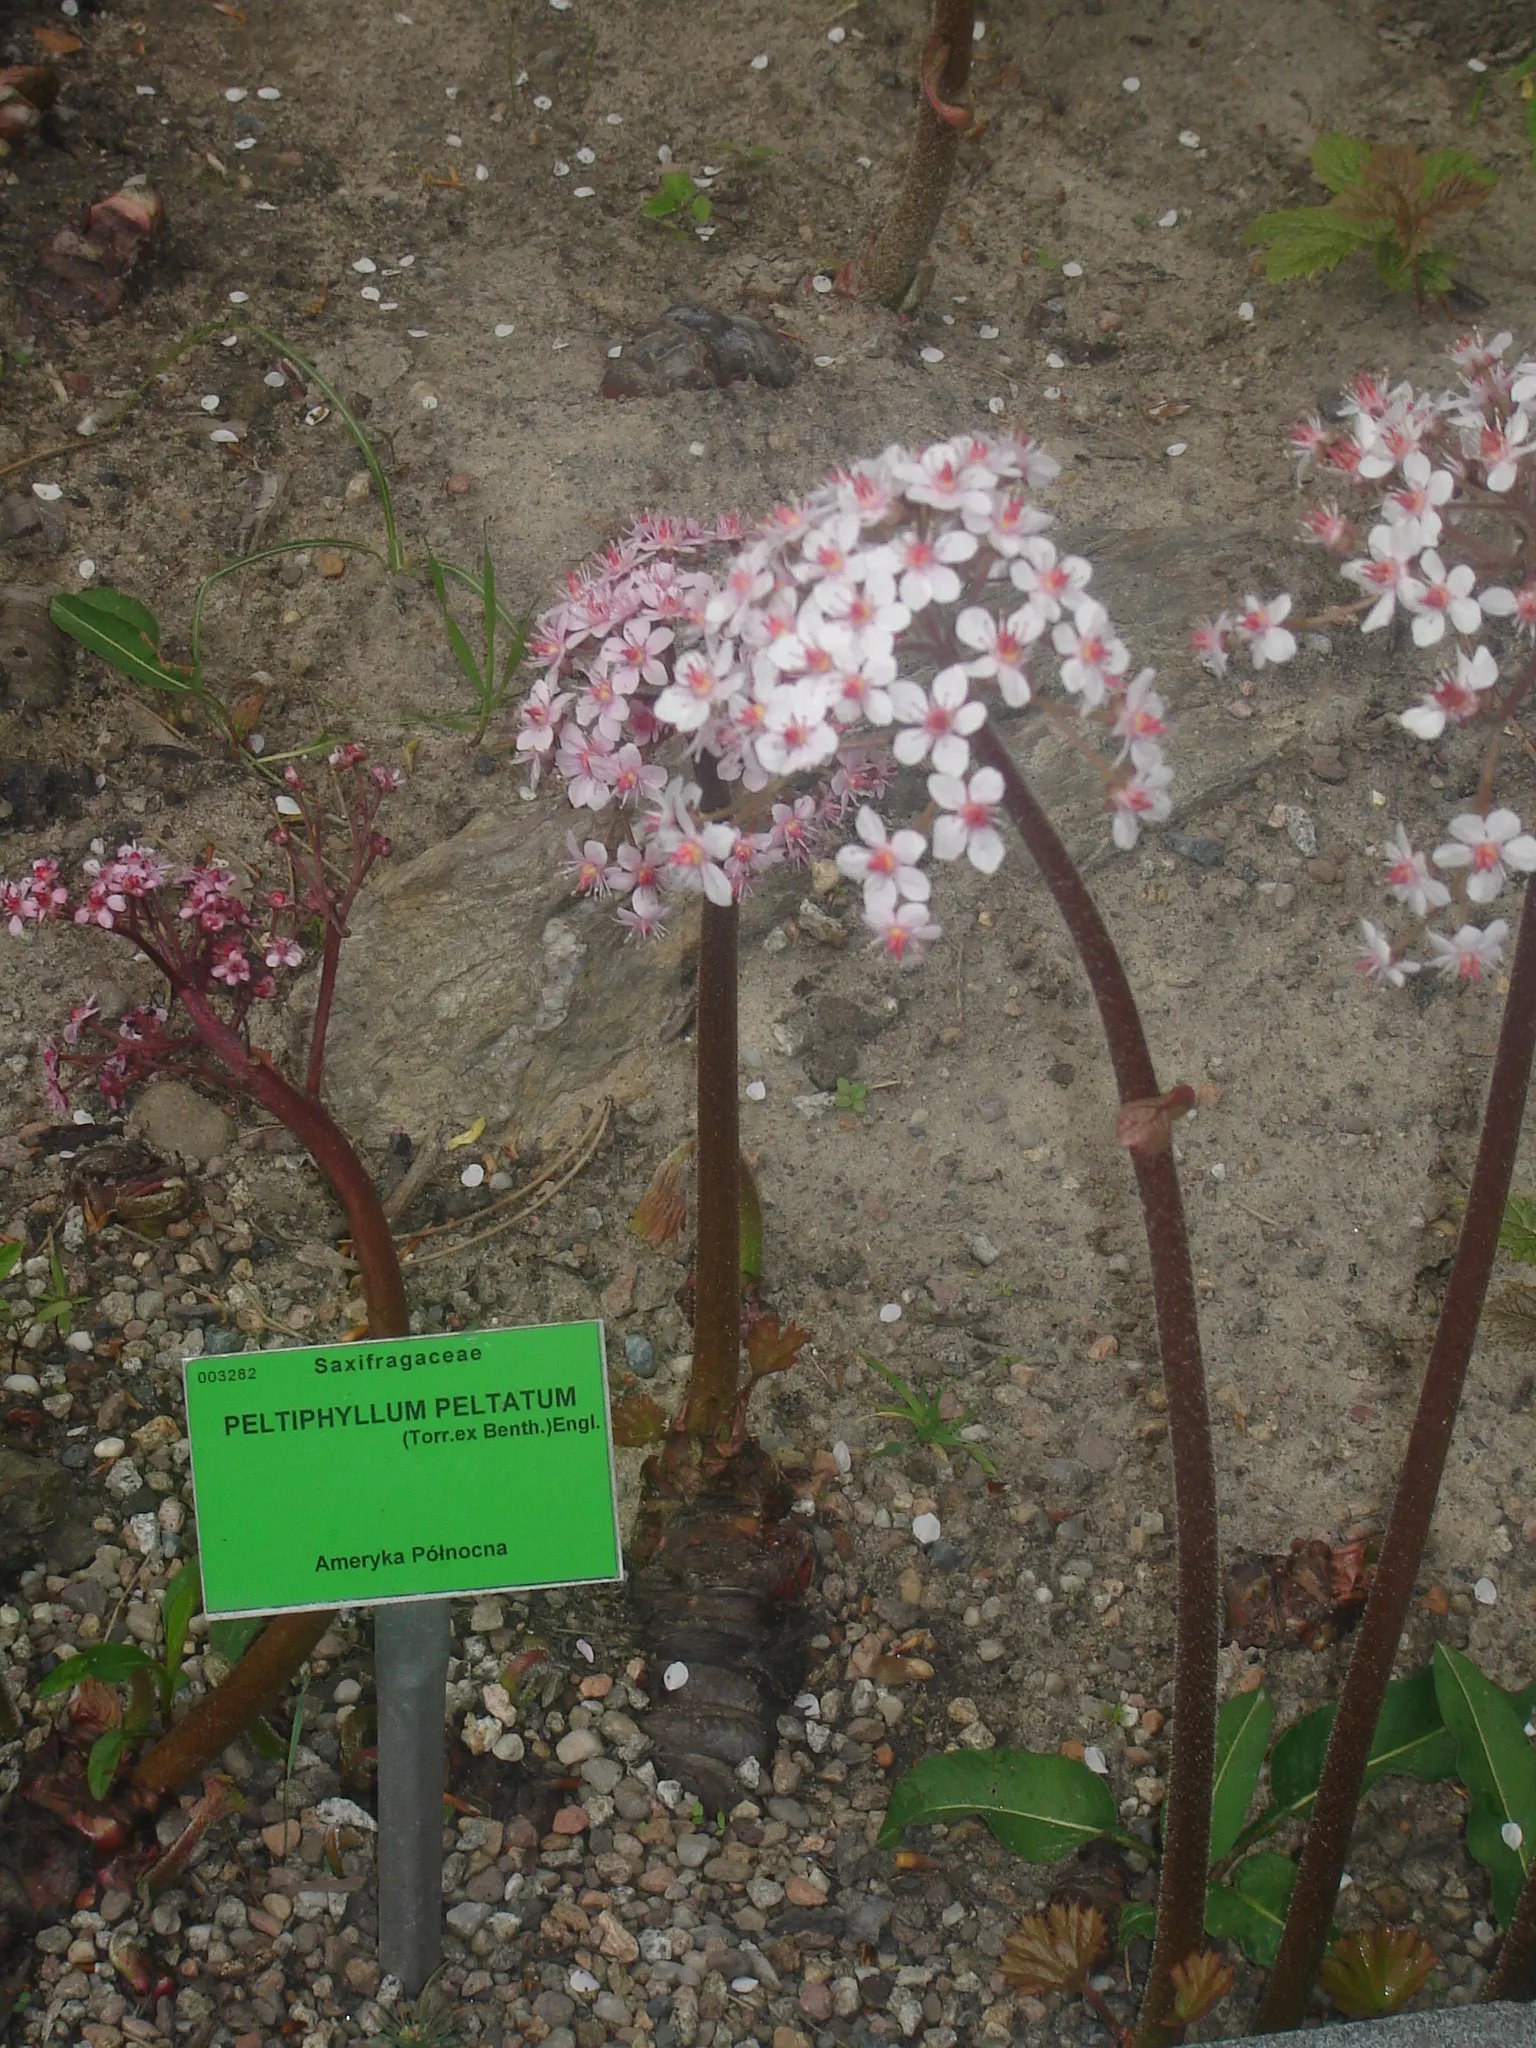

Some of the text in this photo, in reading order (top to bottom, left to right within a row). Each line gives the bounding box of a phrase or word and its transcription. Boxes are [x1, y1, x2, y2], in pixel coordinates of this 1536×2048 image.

[314, 1347, 482, 1374] Saxifragaceae
[198, 1367, 257, 1384] 003282
[224, 1385, 577, 1436] PELTIPHYLLUM PELTATUM
[315, 1542, 508, 1573] Ameryka Północna
